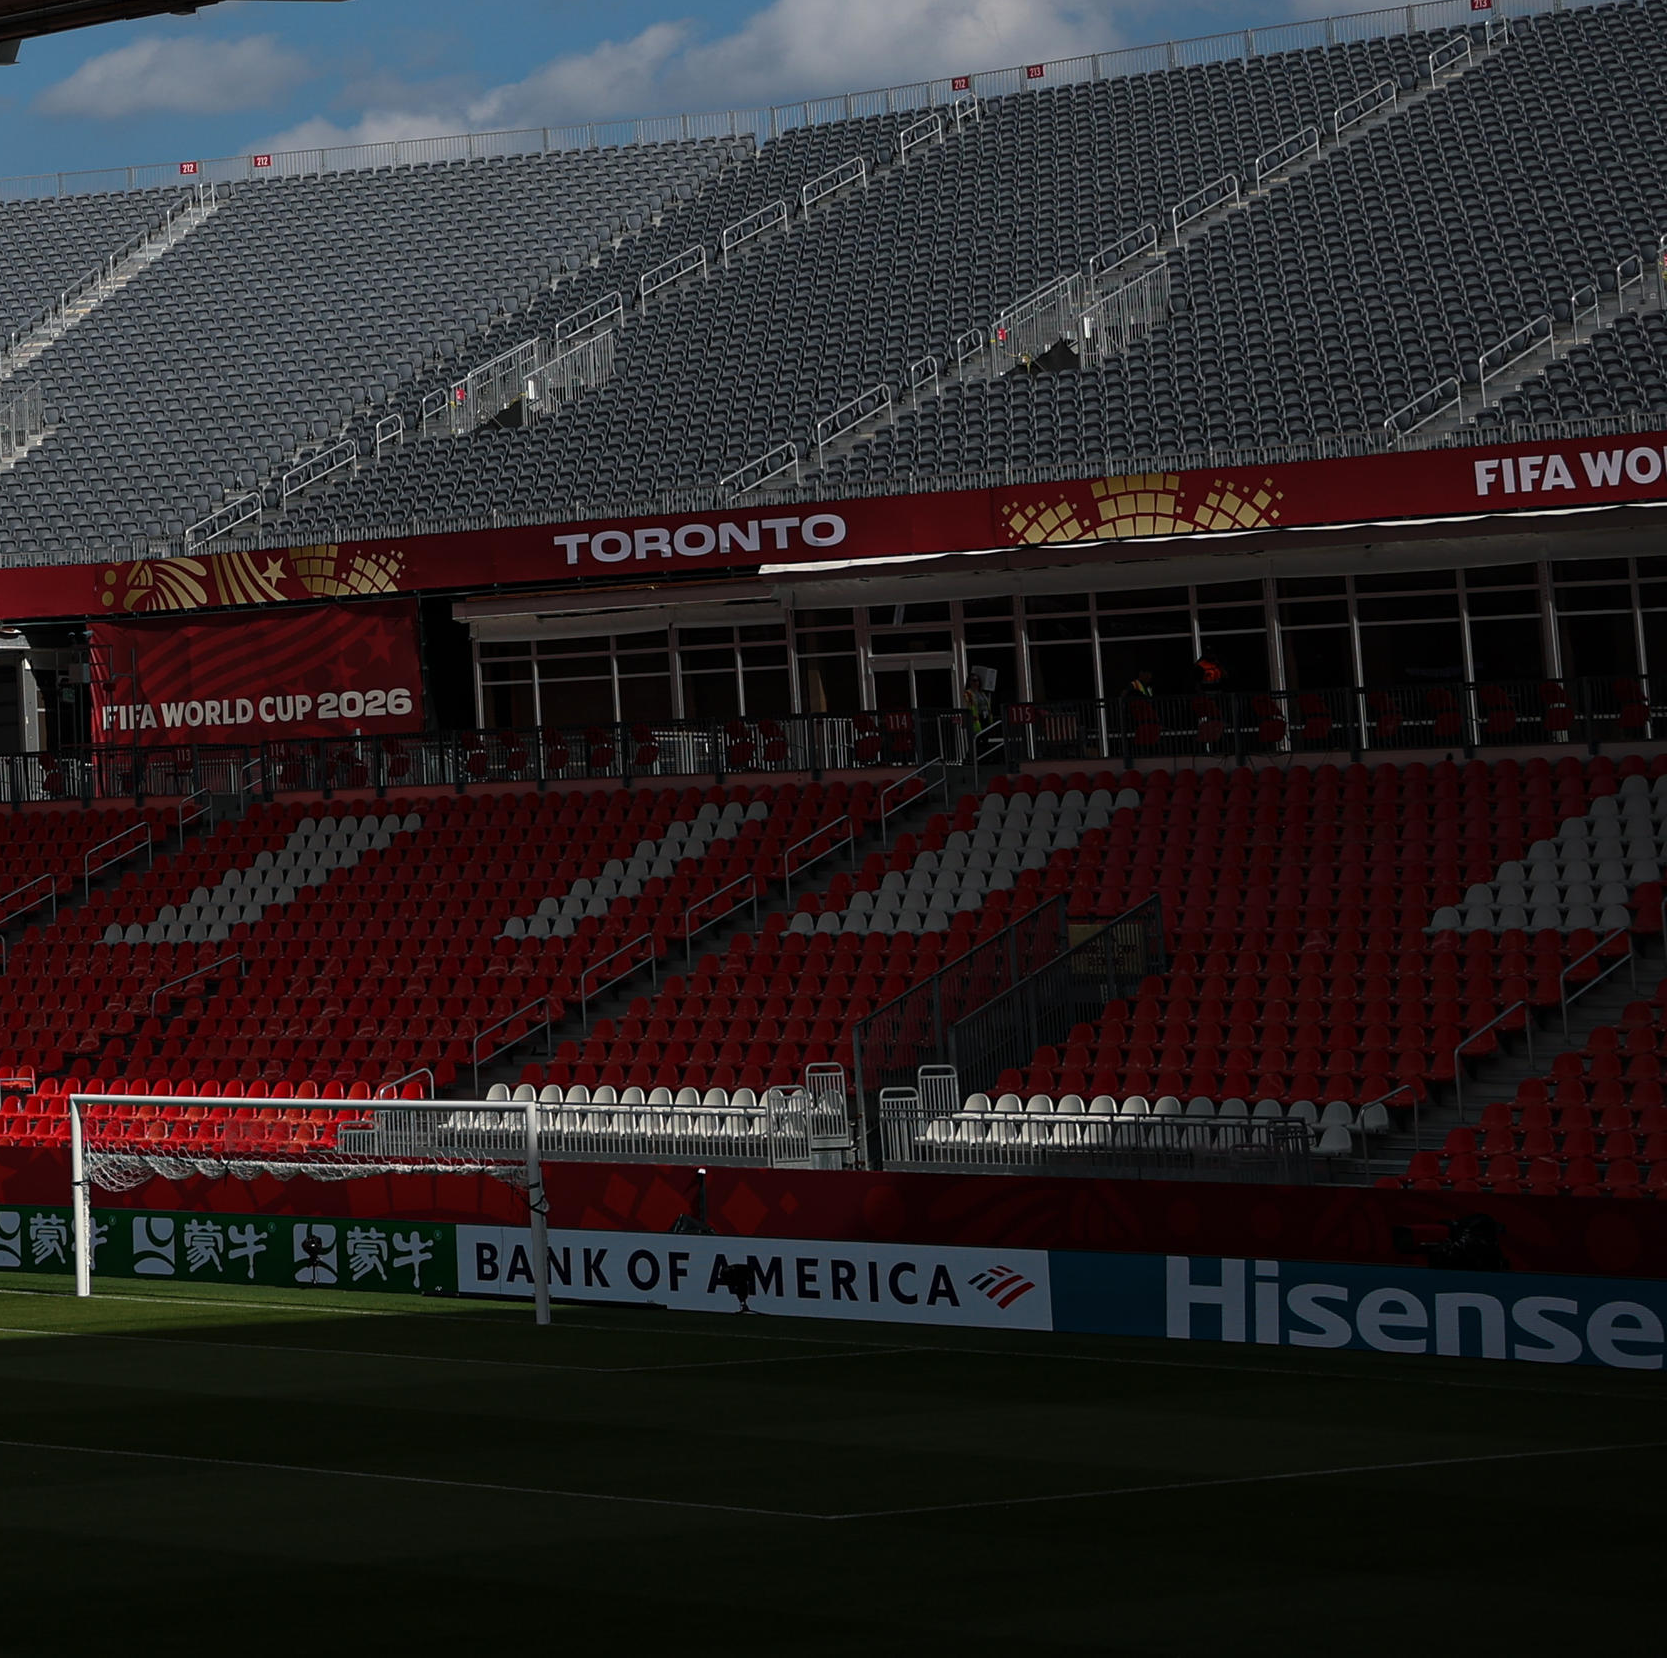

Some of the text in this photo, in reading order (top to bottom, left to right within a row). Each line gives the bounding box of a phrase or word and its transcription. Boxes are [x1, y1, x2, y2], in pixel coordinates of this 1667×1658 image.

[954, 78, 966, 89] 212
[1029, 66, 1043, 77] 213
[182, 163, 194, 174] 212
[257, 156, 268, 166] 212
[1474, 445, 1667, 496] FIFA WO
[553, 513, 847, 565] TORONTO
[101, 687, 414, 732] FIFA WORLD CUP 2026
[889, 714, 907, 729] 114
[1012, 707, 1031, 721] 115
[176, 749, 191, 762] 113
[183, 1218, 269, 1279] 蒙牛
[346, 1226, 434, 1288] 蒙牛
[475, 1242, 960, 1307] BANK OF AMERICA
[1166, 1255, 1665, 1370] Hisense
